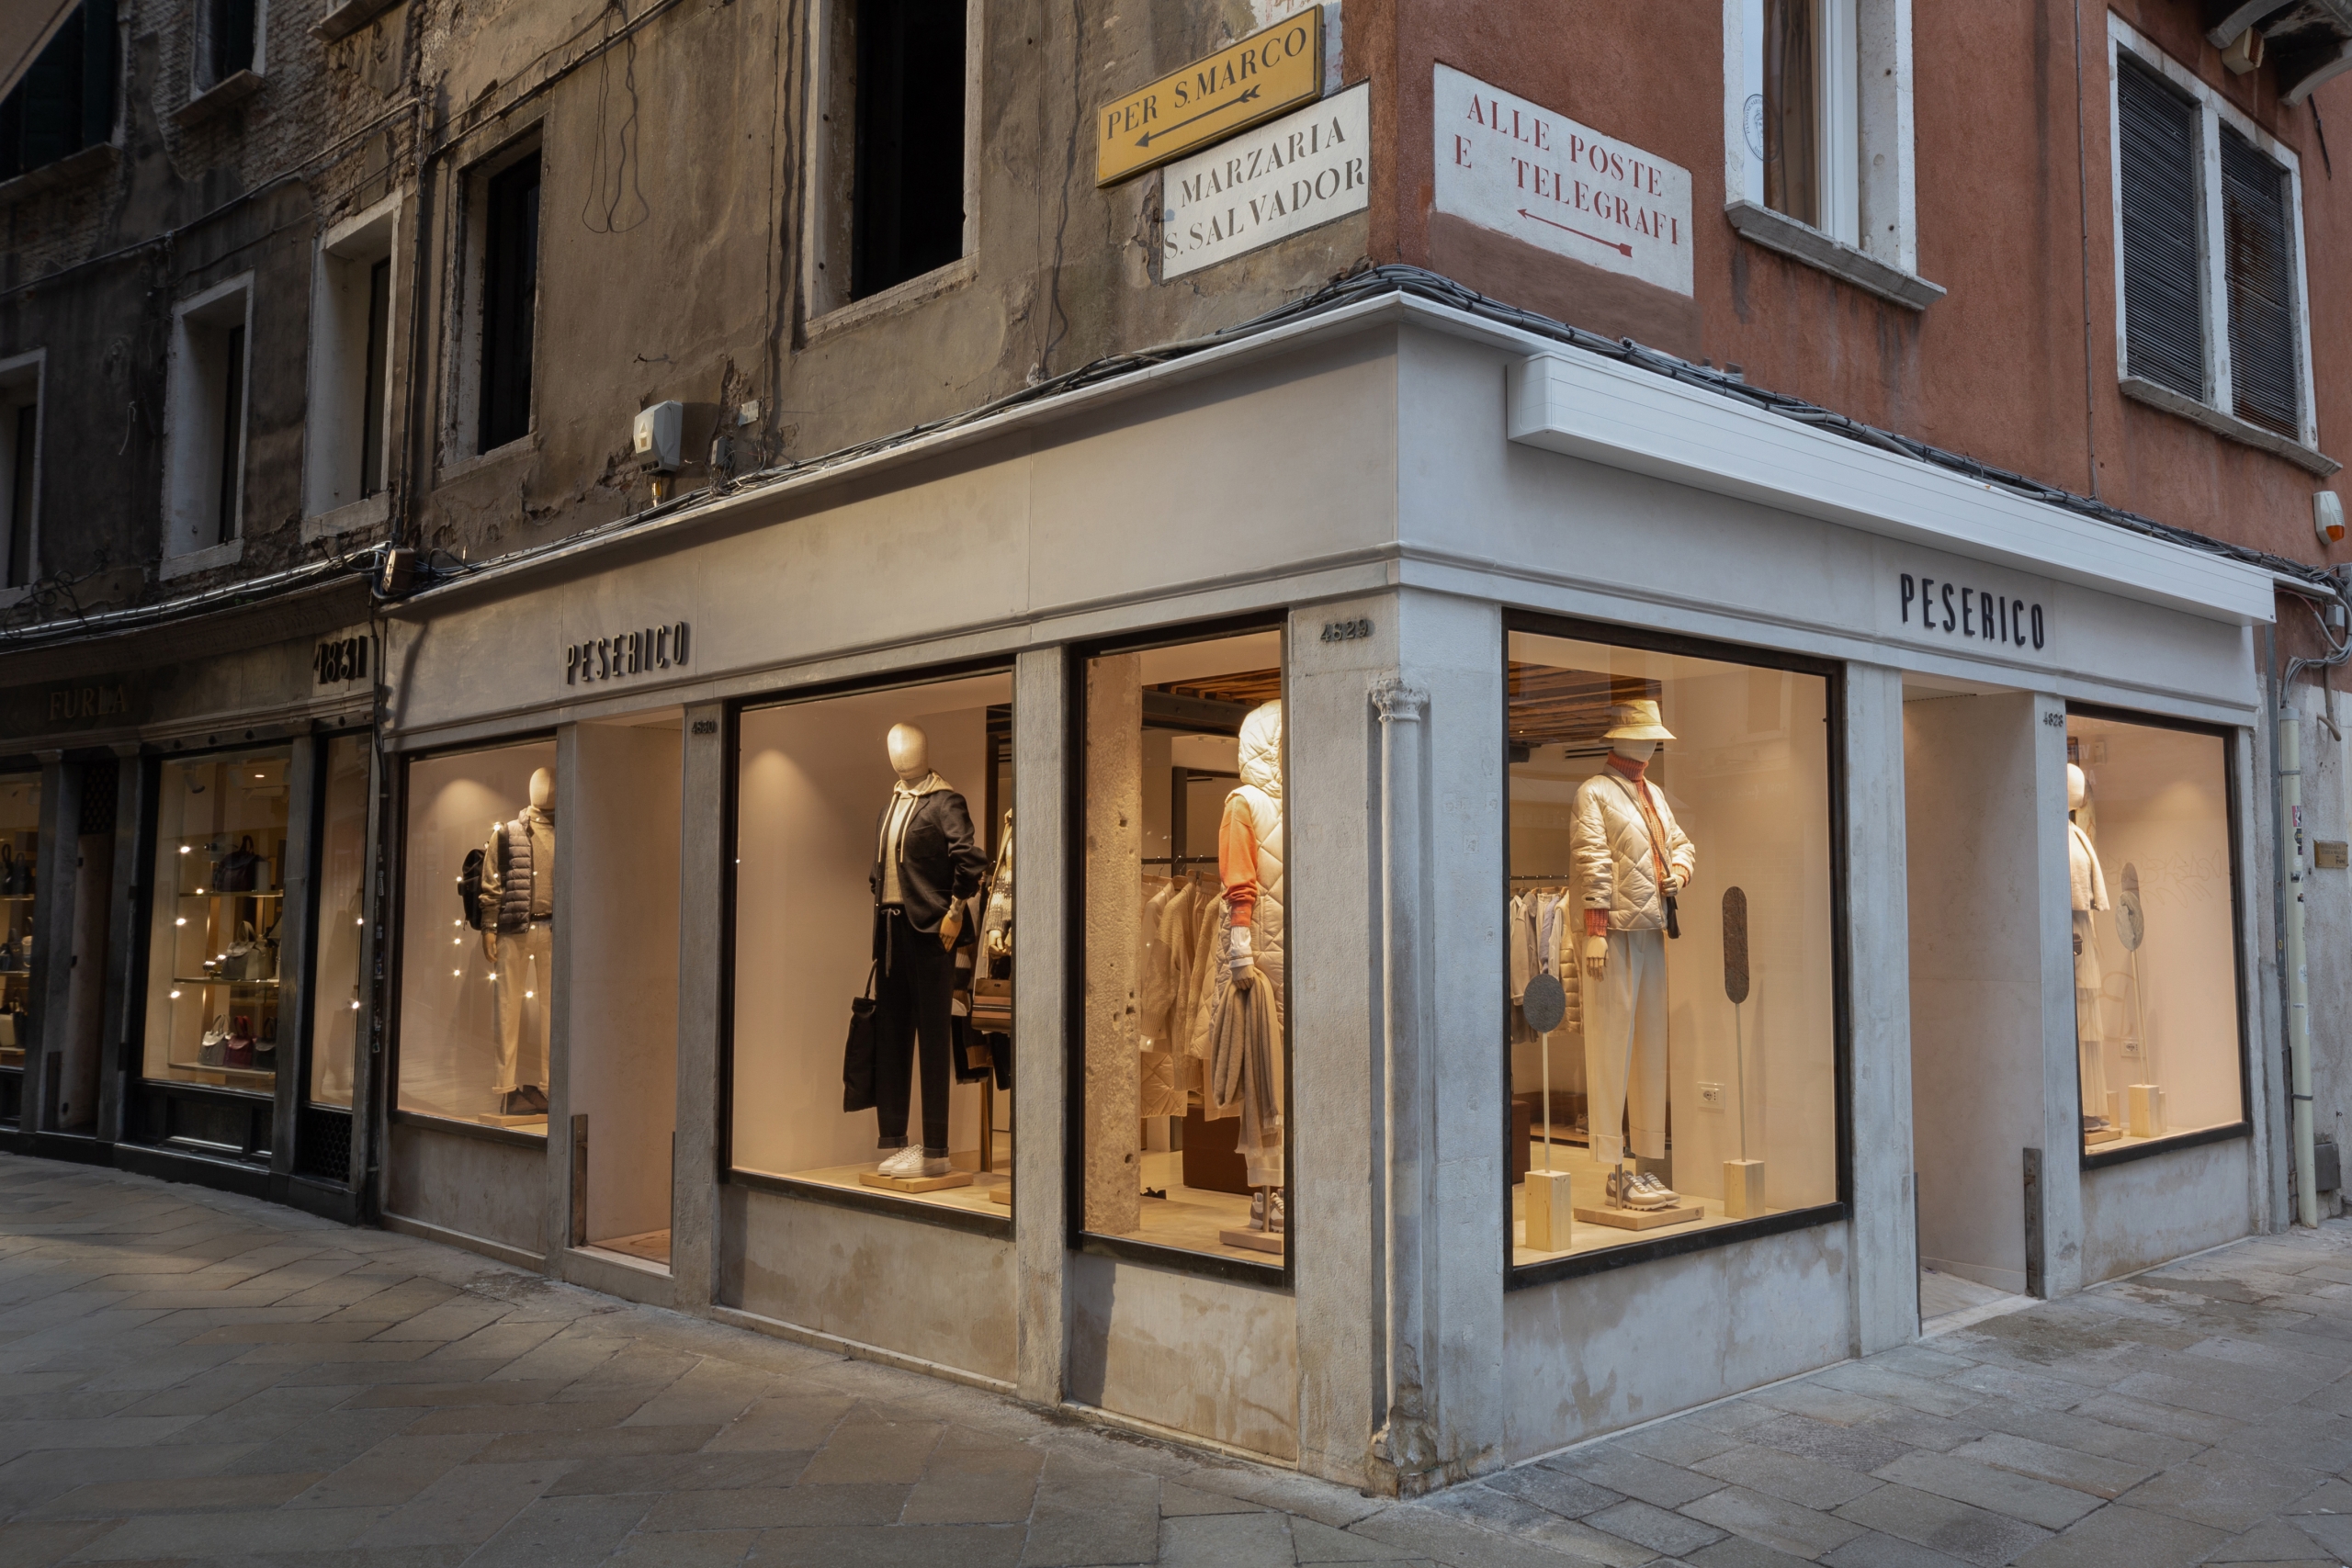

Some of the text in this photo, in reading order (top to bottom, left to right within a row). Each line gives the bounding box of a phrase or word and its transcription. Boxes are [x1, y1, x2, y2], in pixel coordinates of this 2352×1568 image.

[1106, 94, 1159, 141] PER
[1466, 93, 1662, 197] ALLE POSTE
[1181, 116, 1346, 209] MARZARIA
[1454, 133, 1679, 245] E TELEGRAFI
[1320, 619, 1370, 643] 4829
[1900, 573, 2045, 649] PESERICO
[566, 621, 687, 685] PESERICO
[49, 684, 128, 721] FURLA
[2042, 711, 2064, 728] 4828
